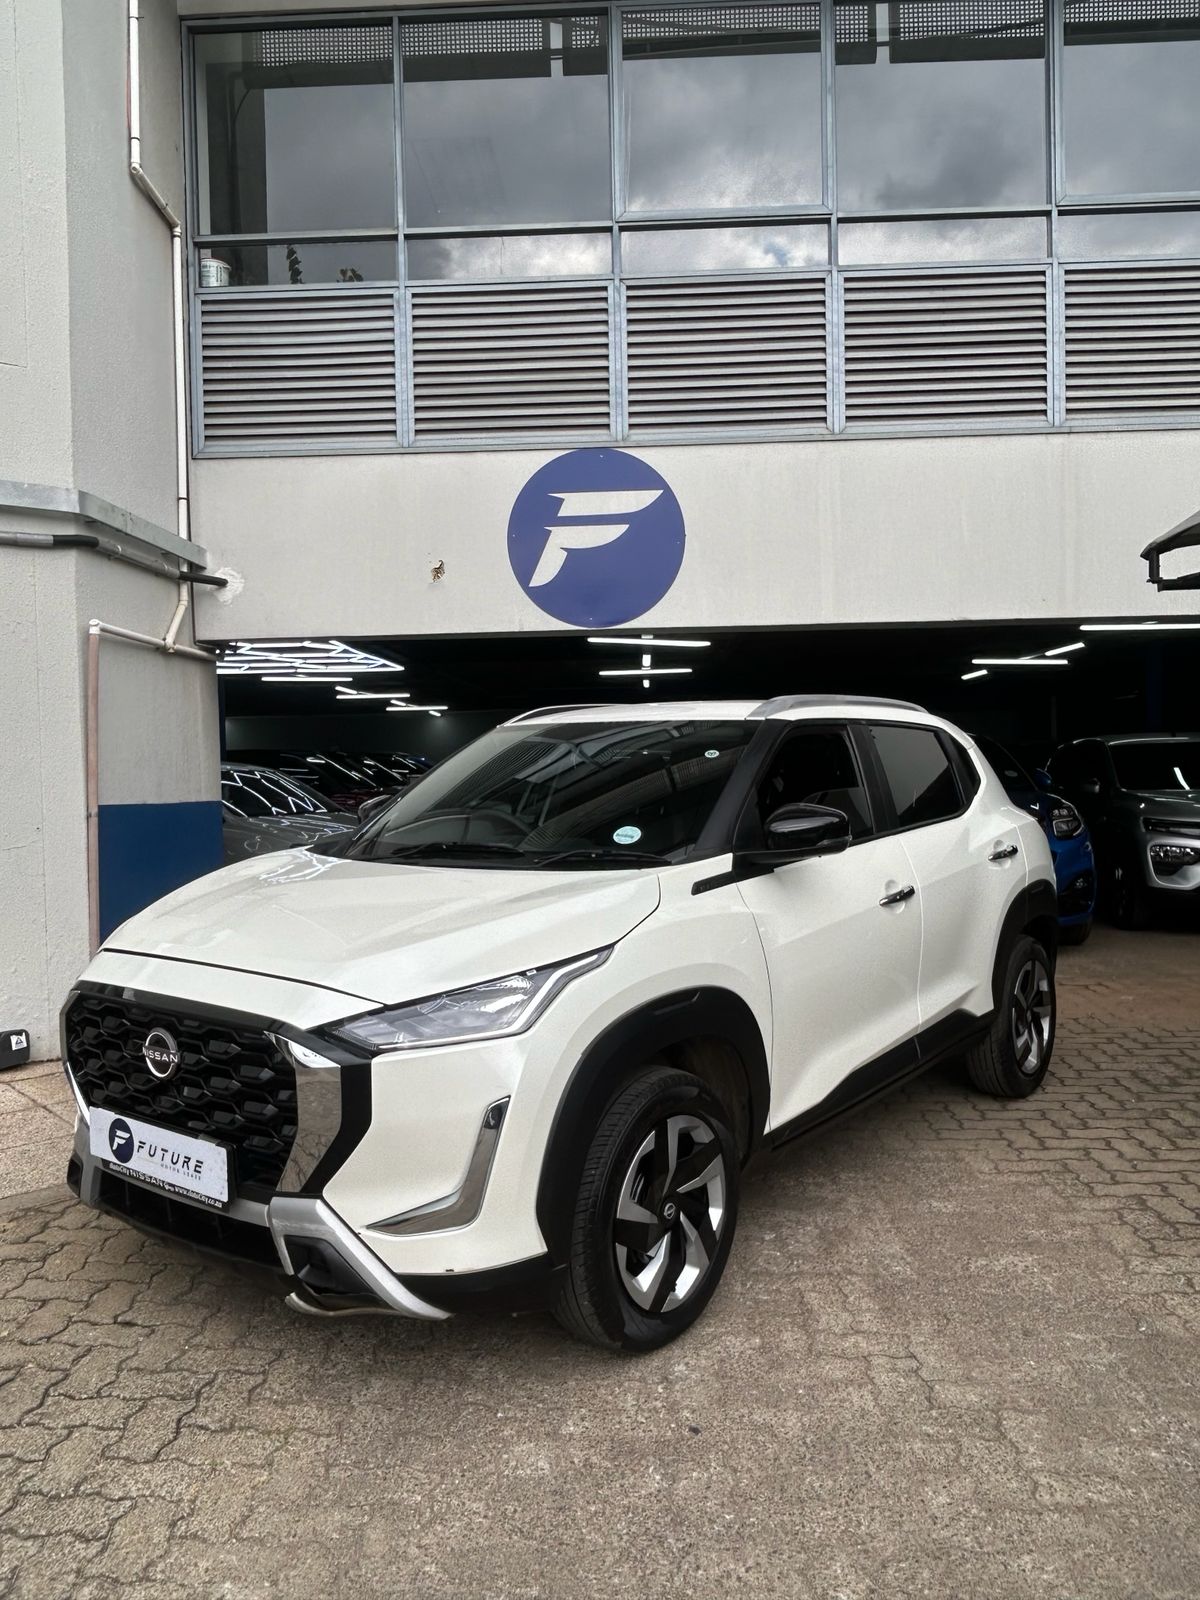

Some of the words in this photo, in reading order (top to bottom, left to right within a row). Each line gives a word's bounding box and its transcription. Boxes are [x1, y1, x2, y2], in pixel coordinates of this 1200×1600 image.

[528, 489, 664, 588] F
[142, 1046, 178, 1064] NISSAN
[137, 1140, 204, 1174] FUTURE
[130, 1169, 164, 1188] NISSAN
